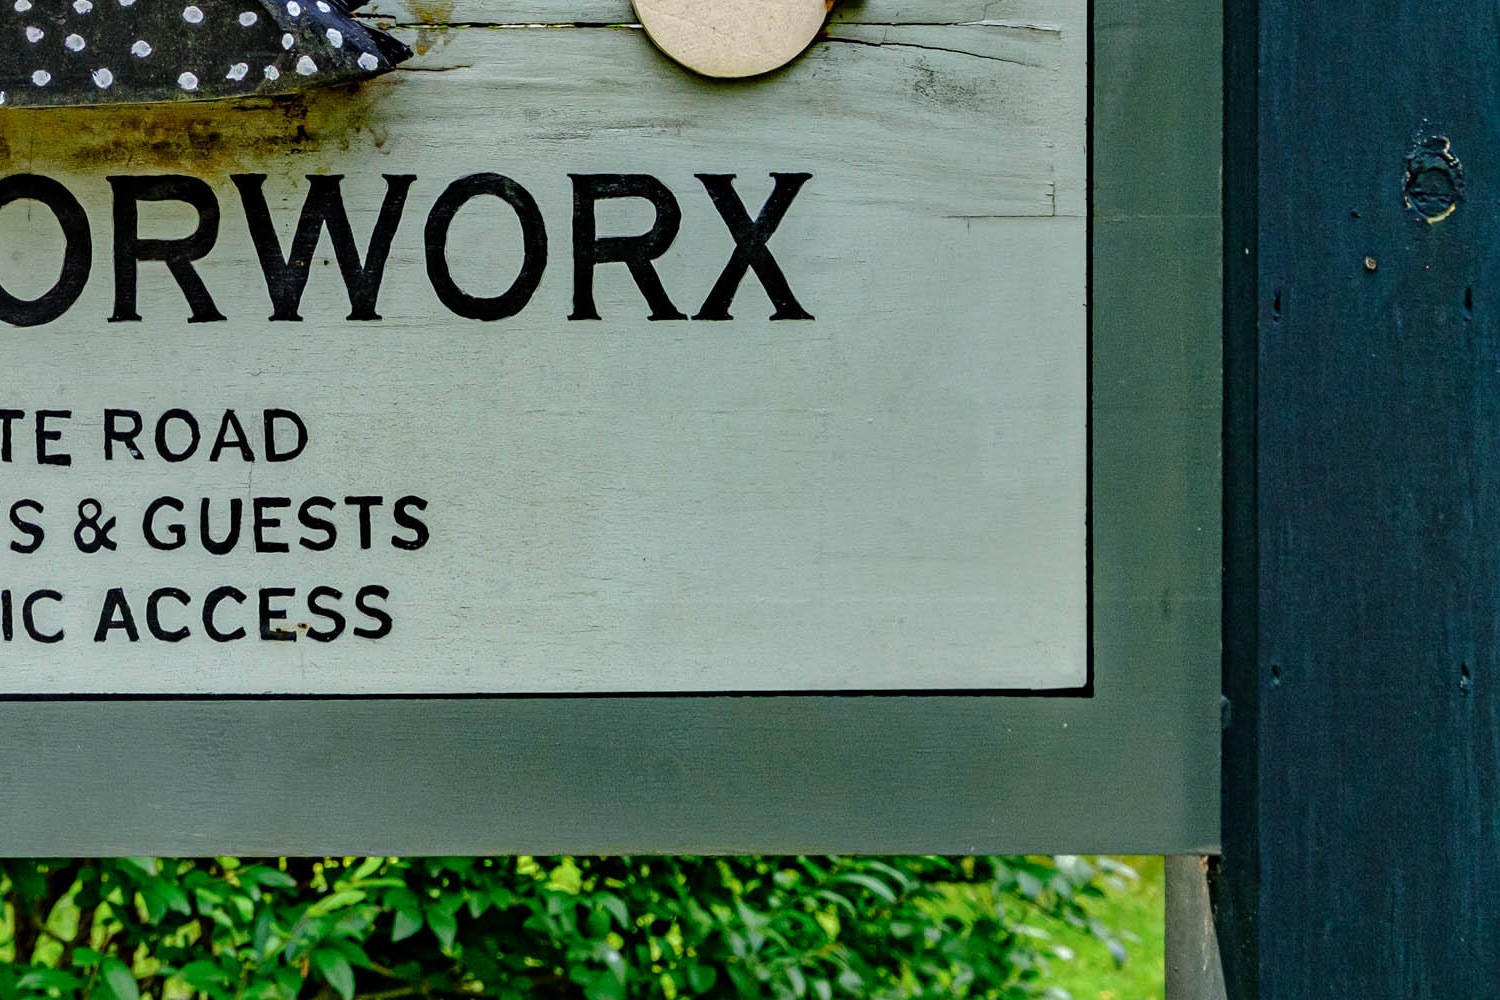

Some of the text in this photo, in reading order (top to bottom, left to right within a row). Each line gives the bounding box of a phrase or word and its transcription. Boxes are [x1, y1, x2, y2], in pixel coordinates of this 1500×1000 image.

[103, 408, 309, 464] ROAD
[73, 497, 118, 554] &
[142, 495, 430, 556] GUESTS
[93, 584, 393, 643] ACCESS
